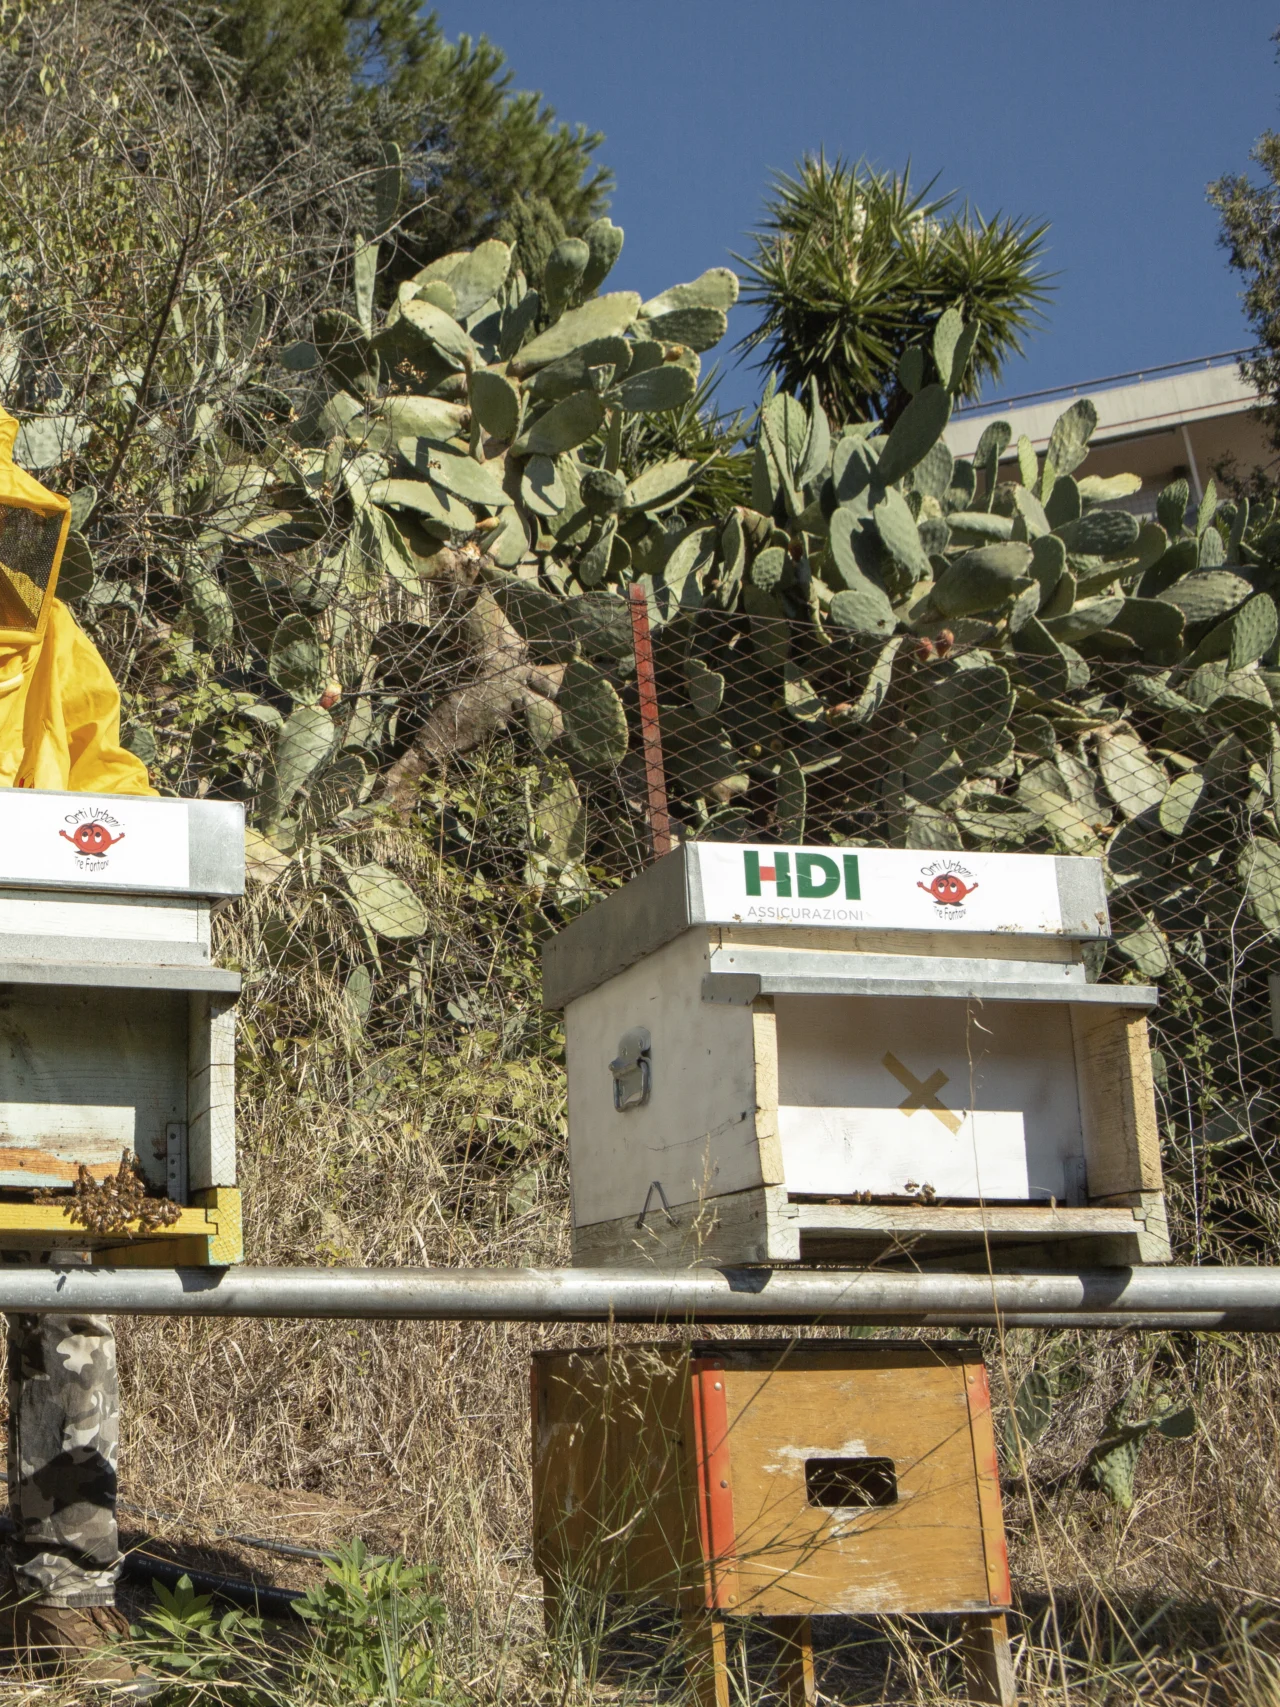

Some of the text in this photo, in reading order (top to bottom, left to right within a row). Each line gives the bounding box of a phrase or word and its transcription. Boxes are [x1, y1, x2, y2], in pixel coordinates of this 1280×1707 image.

[64, 806, 126, 828] Orti Urbani
[74, 855, 84, 870] Tre
[920, 859, 978, 878] Orti Urbani
[743, 850, 862, 901] HDI
[747, 906, 864, 921] ASSICURAZIONI
[932, 905, 943, 919] Tre
